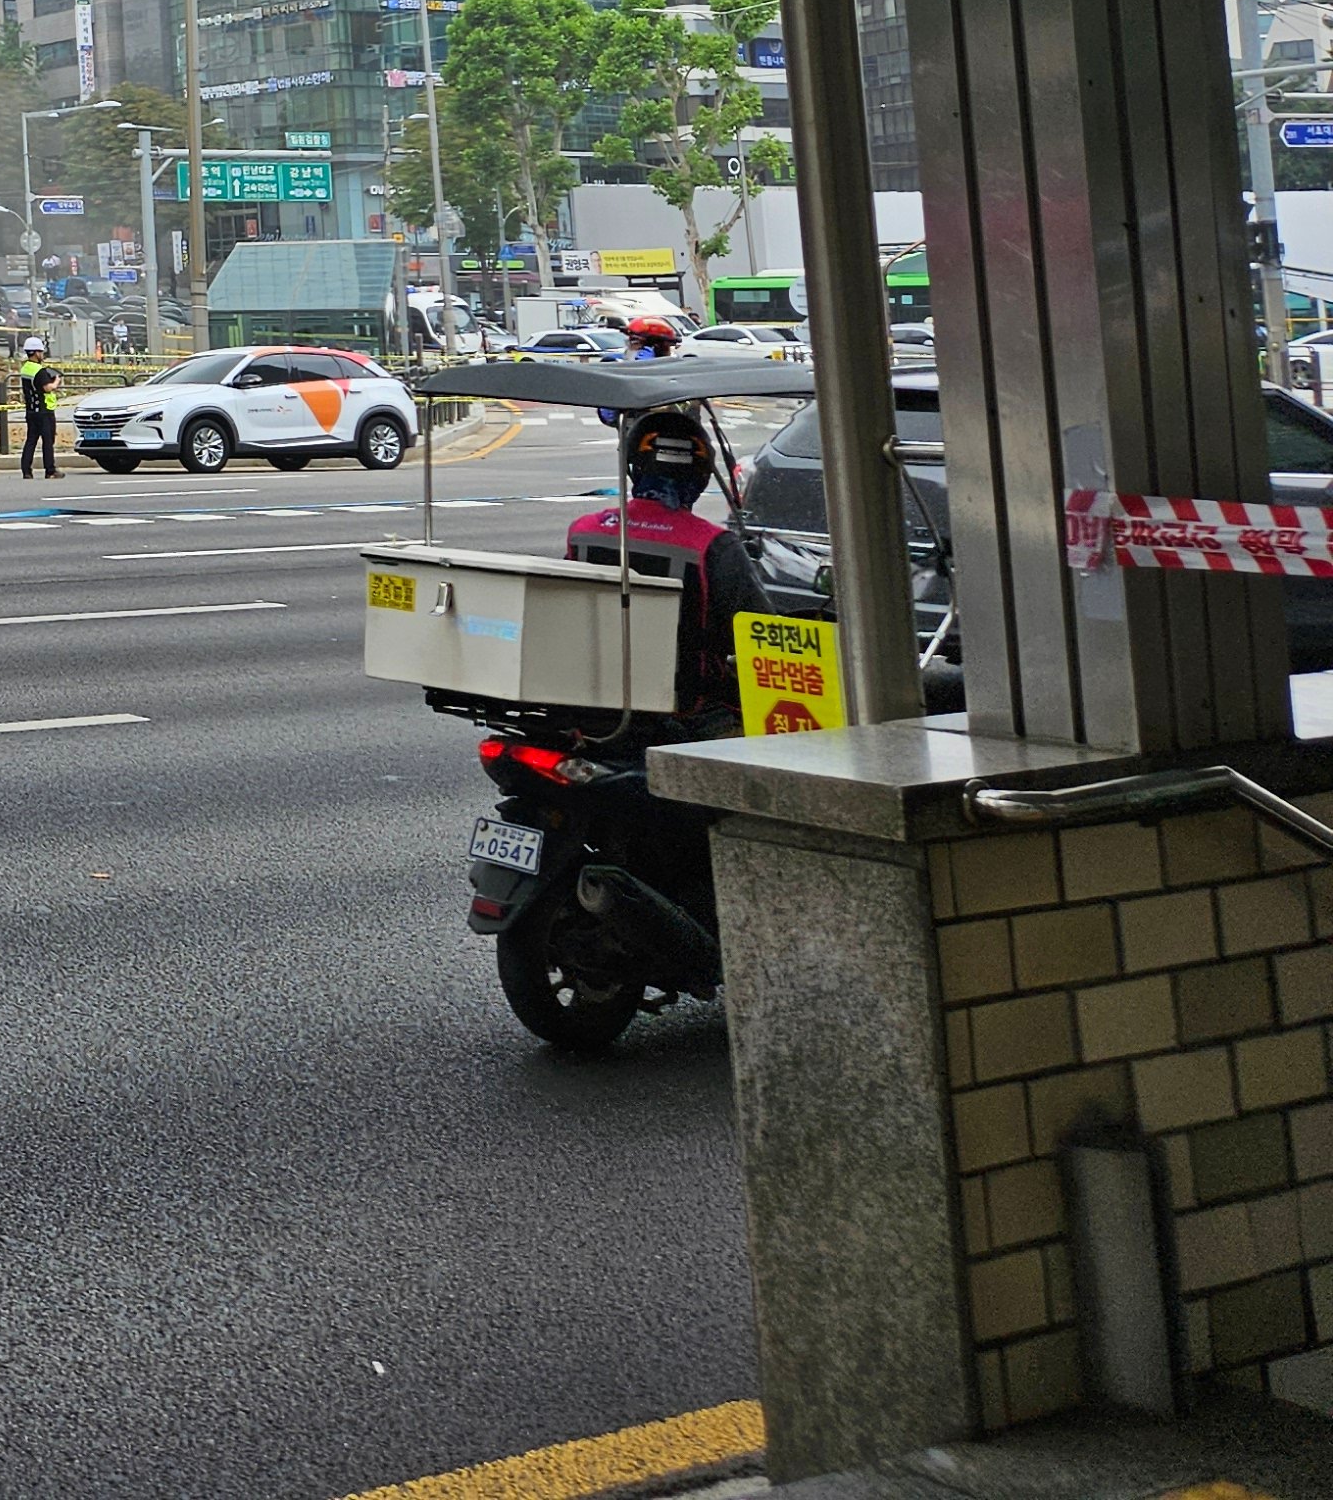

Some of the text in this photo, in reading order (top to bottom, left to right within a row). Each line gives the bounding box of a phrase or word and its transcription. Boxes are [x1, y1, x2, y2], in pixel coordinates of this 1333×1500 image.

[1306, 125, 1333, 136] 서초대
[289, 166, 324, 178] 강남역
[564, 258, 590, 271] 권영국
[750, 620, 822, 658] 우회전시
[751, 656, 824, 696] 일단멈춤
[773, 712, 812, 734] 정지
[488, 837, 535, 866] 0547
